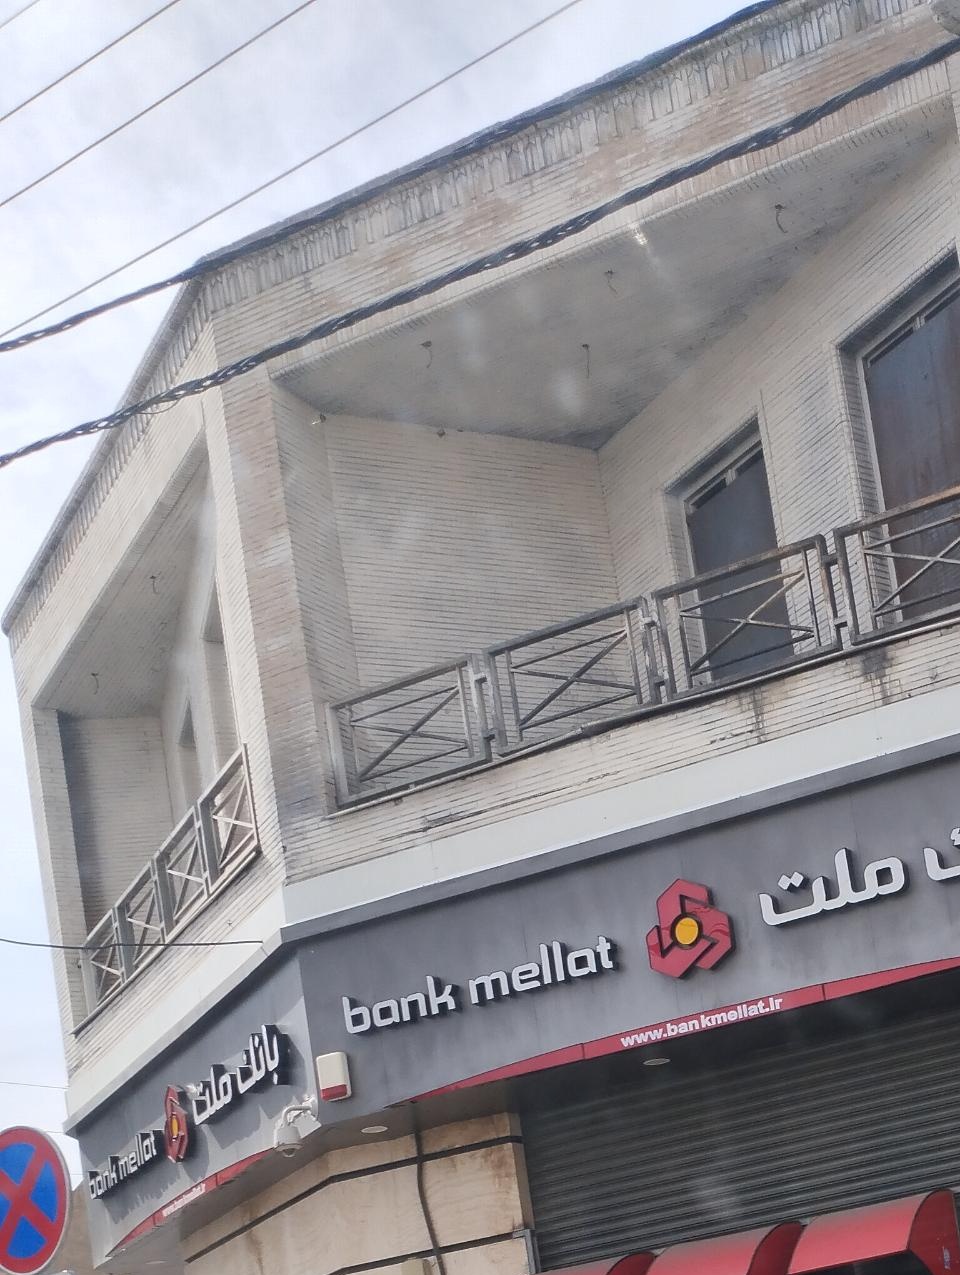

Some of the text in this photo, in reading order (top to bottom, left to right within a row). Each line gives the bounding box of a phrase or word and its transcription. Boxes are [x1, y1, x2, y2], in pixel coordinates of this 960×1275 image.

[758, 847, 906, 926] ملت
[342, 935, 614, 1034] bank mellat
[620, 997, 783, 1047] www.bankmellat.ir
[187, 1065, 233, 1126] ملت
[88, 1155, 118, 1200] bank
[118, 1130, 158, 1176] mellat
